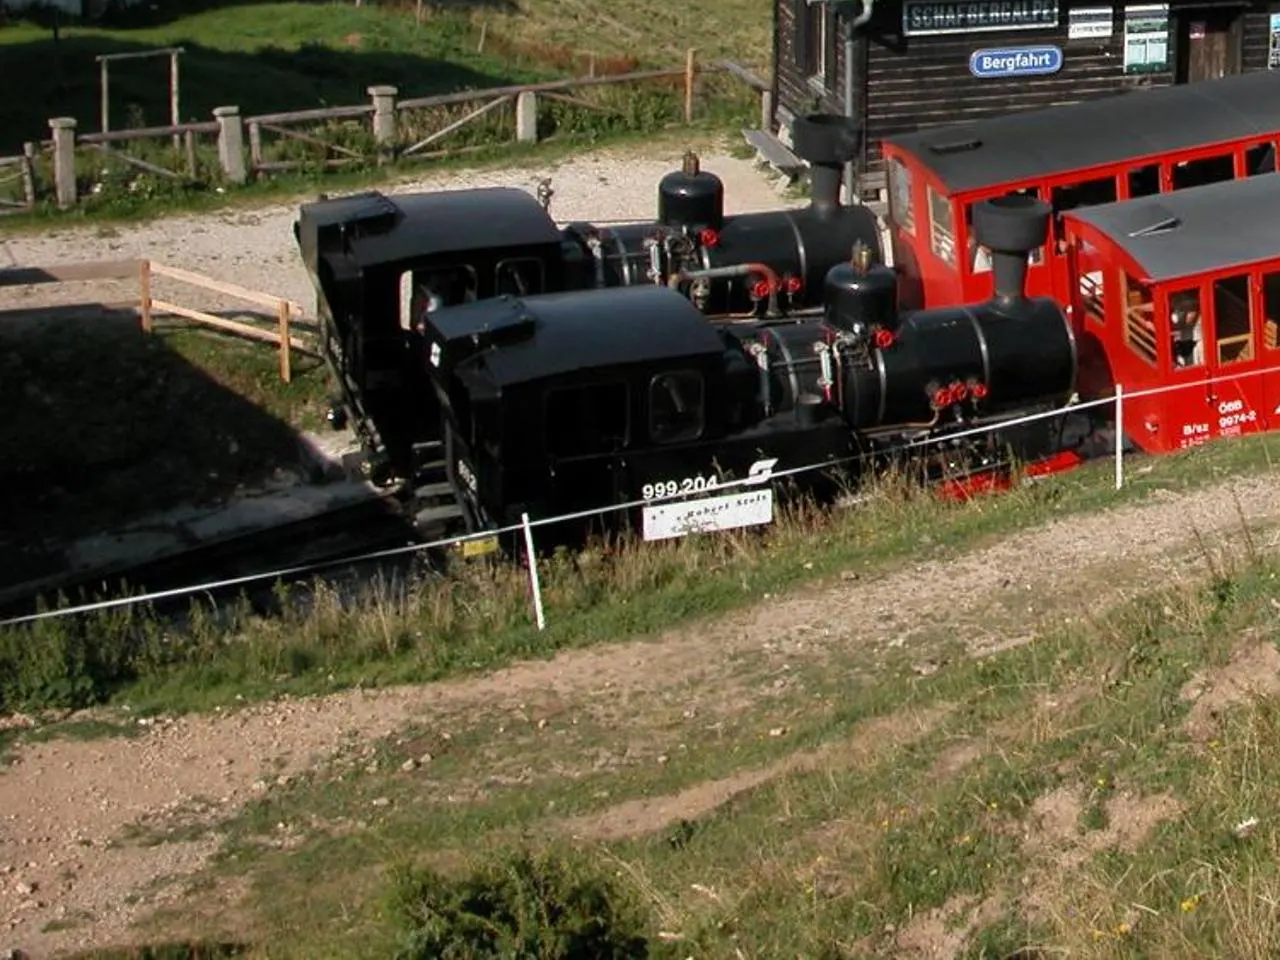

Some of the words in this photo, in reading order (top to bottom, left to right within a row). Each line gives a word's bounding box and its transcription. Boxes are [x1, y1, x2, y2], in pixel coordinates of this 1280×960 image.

[911, 0, 1051, 28] SCHAFBERGALPE
[983, 53, 1050, 71] Bergfahrt
[642, 474, 717, 499] 999.204
